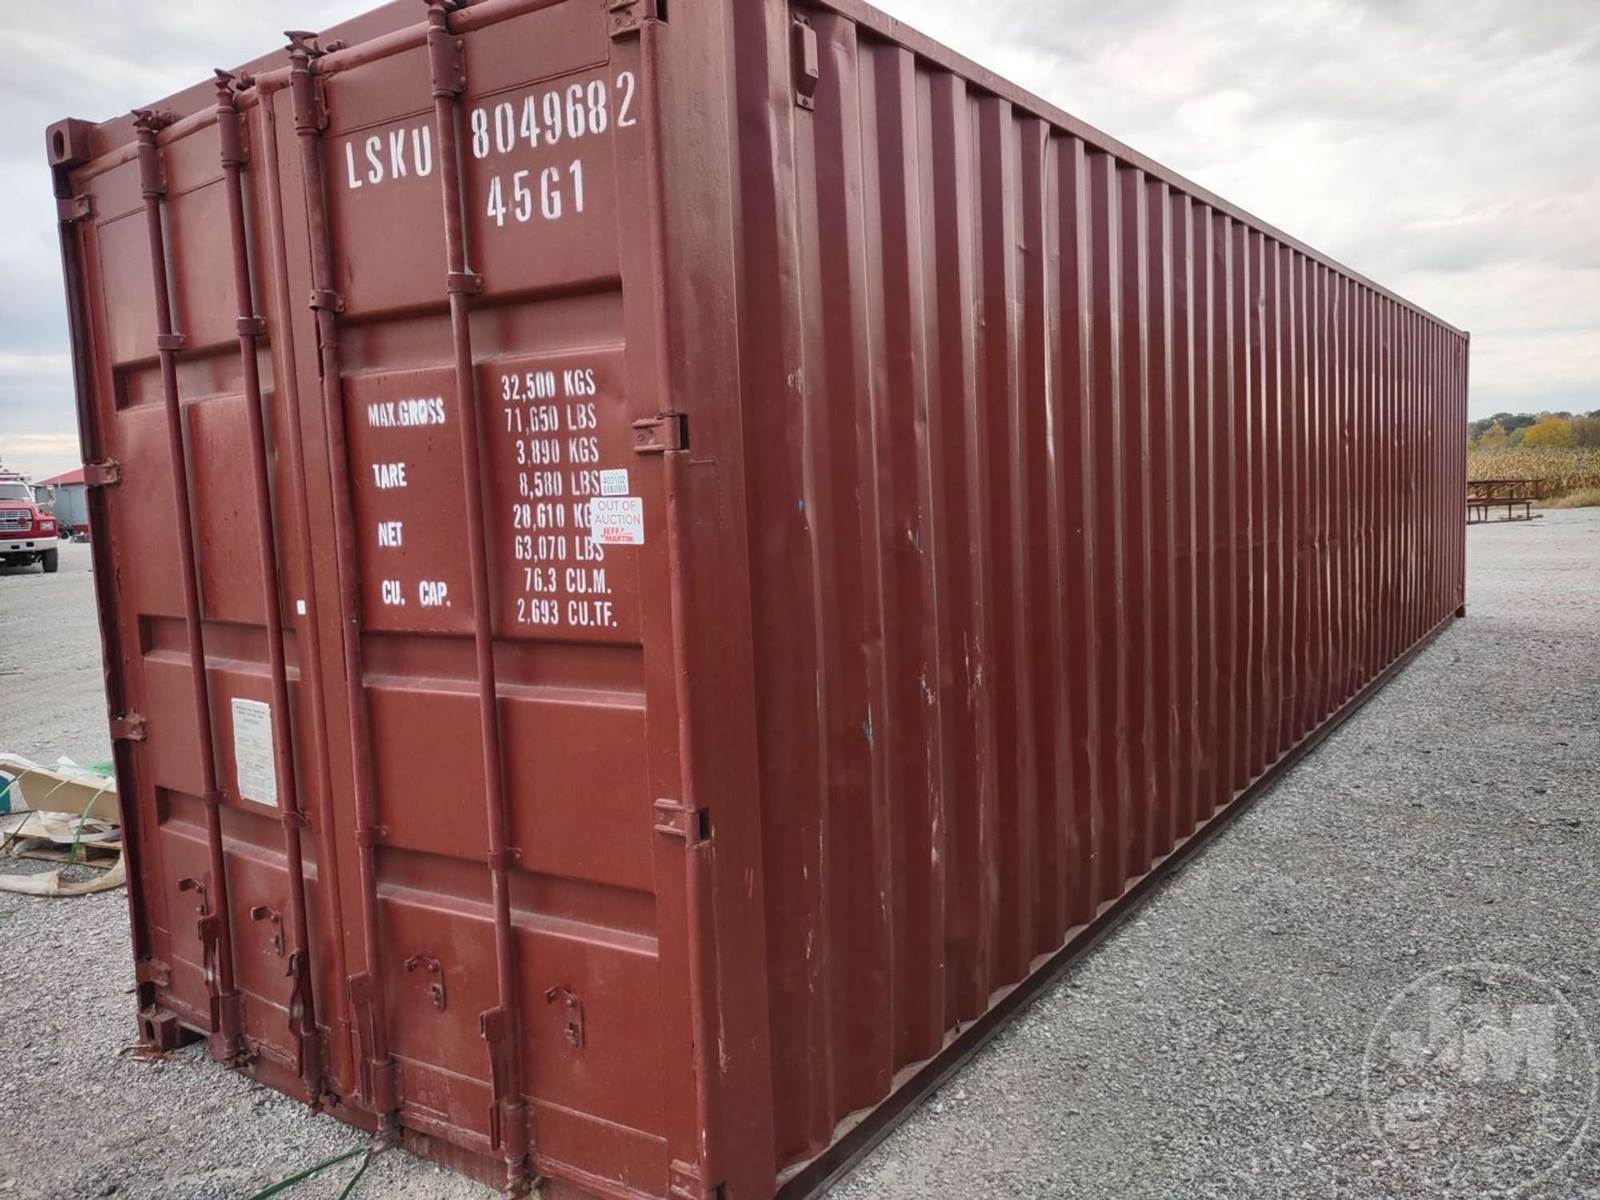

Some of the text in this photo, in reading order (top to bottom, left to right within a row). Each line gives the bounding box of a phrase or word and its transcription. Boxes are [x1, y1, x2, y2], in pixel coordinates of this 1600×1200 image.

[345, 71, 636, 189] LSKU 8049682
[487, 159, 584, 226] 45G1
[502, 369, 595, 401] 32,500 KGS
[368, 398, 445, 426] MAX.GROSS
[505, 403, 596, 434] 71,650 LBS
[516, 437, 599, 464] 3,890 KGS
[373, 463, 407, 489] TARE
[520, 470, 600, 499] 8,580 LBS
[513, 503, 591, 530] 28,610 KG
[595, 514, 640, 525] AUCTION
[598, 501, 636, 511] OUT OF
[379, 522, 402, 546] NET
[516, 535, 604, 562] 63,070 LBS
[382, 580, 450, 606] CU. CAP.
[525, 568, 611, 593] 76.3 CU.M.
[518, 599, 617, 626] 2,693 CU.TF.
